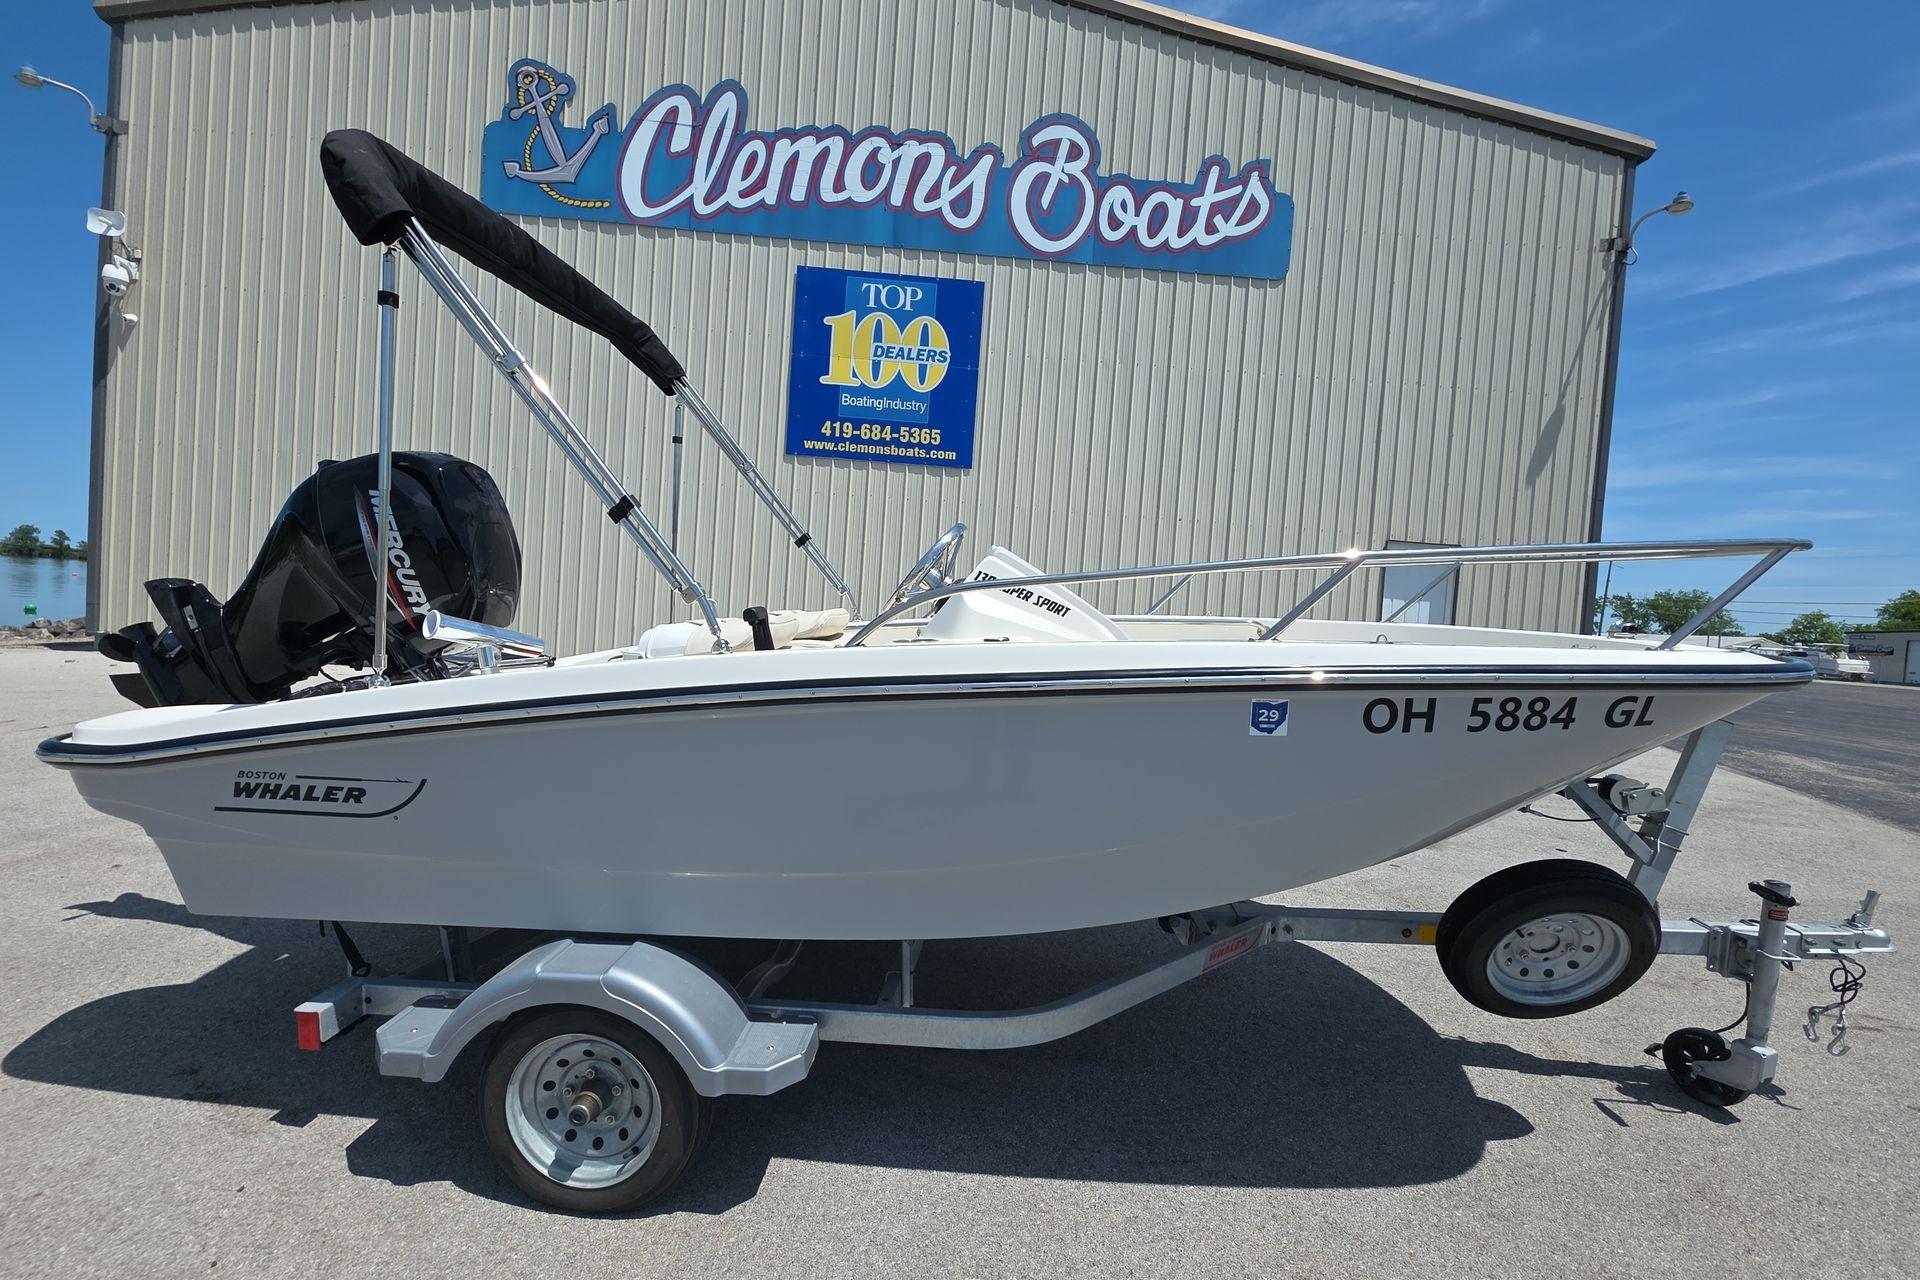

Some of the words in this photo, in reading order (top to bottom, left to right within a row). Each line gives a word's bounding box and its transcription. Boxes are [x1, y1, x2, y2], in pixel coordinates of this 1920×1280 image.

[619, 88, 996, 231] Clemons
[1010, 124, 1270, 253] Boats
[861, 282, 923, 312] TOP
[819, 310, 951, 393] 100
[872, 343, 950, 364] DEALERS
[821, 420, 942, 446] 419-684-5365
[803, 439, 957, 461] www.clemonsboats.com
[1000, 586, 1034, 602] PER
[1032, 595, 1072, 618] SPORT
[1258, 709, 1280, 722] 29
[1362, 697, 1437, 734] OH
[1466, 696, 1578, 733] 5884
[1603, 695, 1656, 729] GL
[236, 769, 288, 781] BOSTON
[232, 781, 368, 804] WHALER
